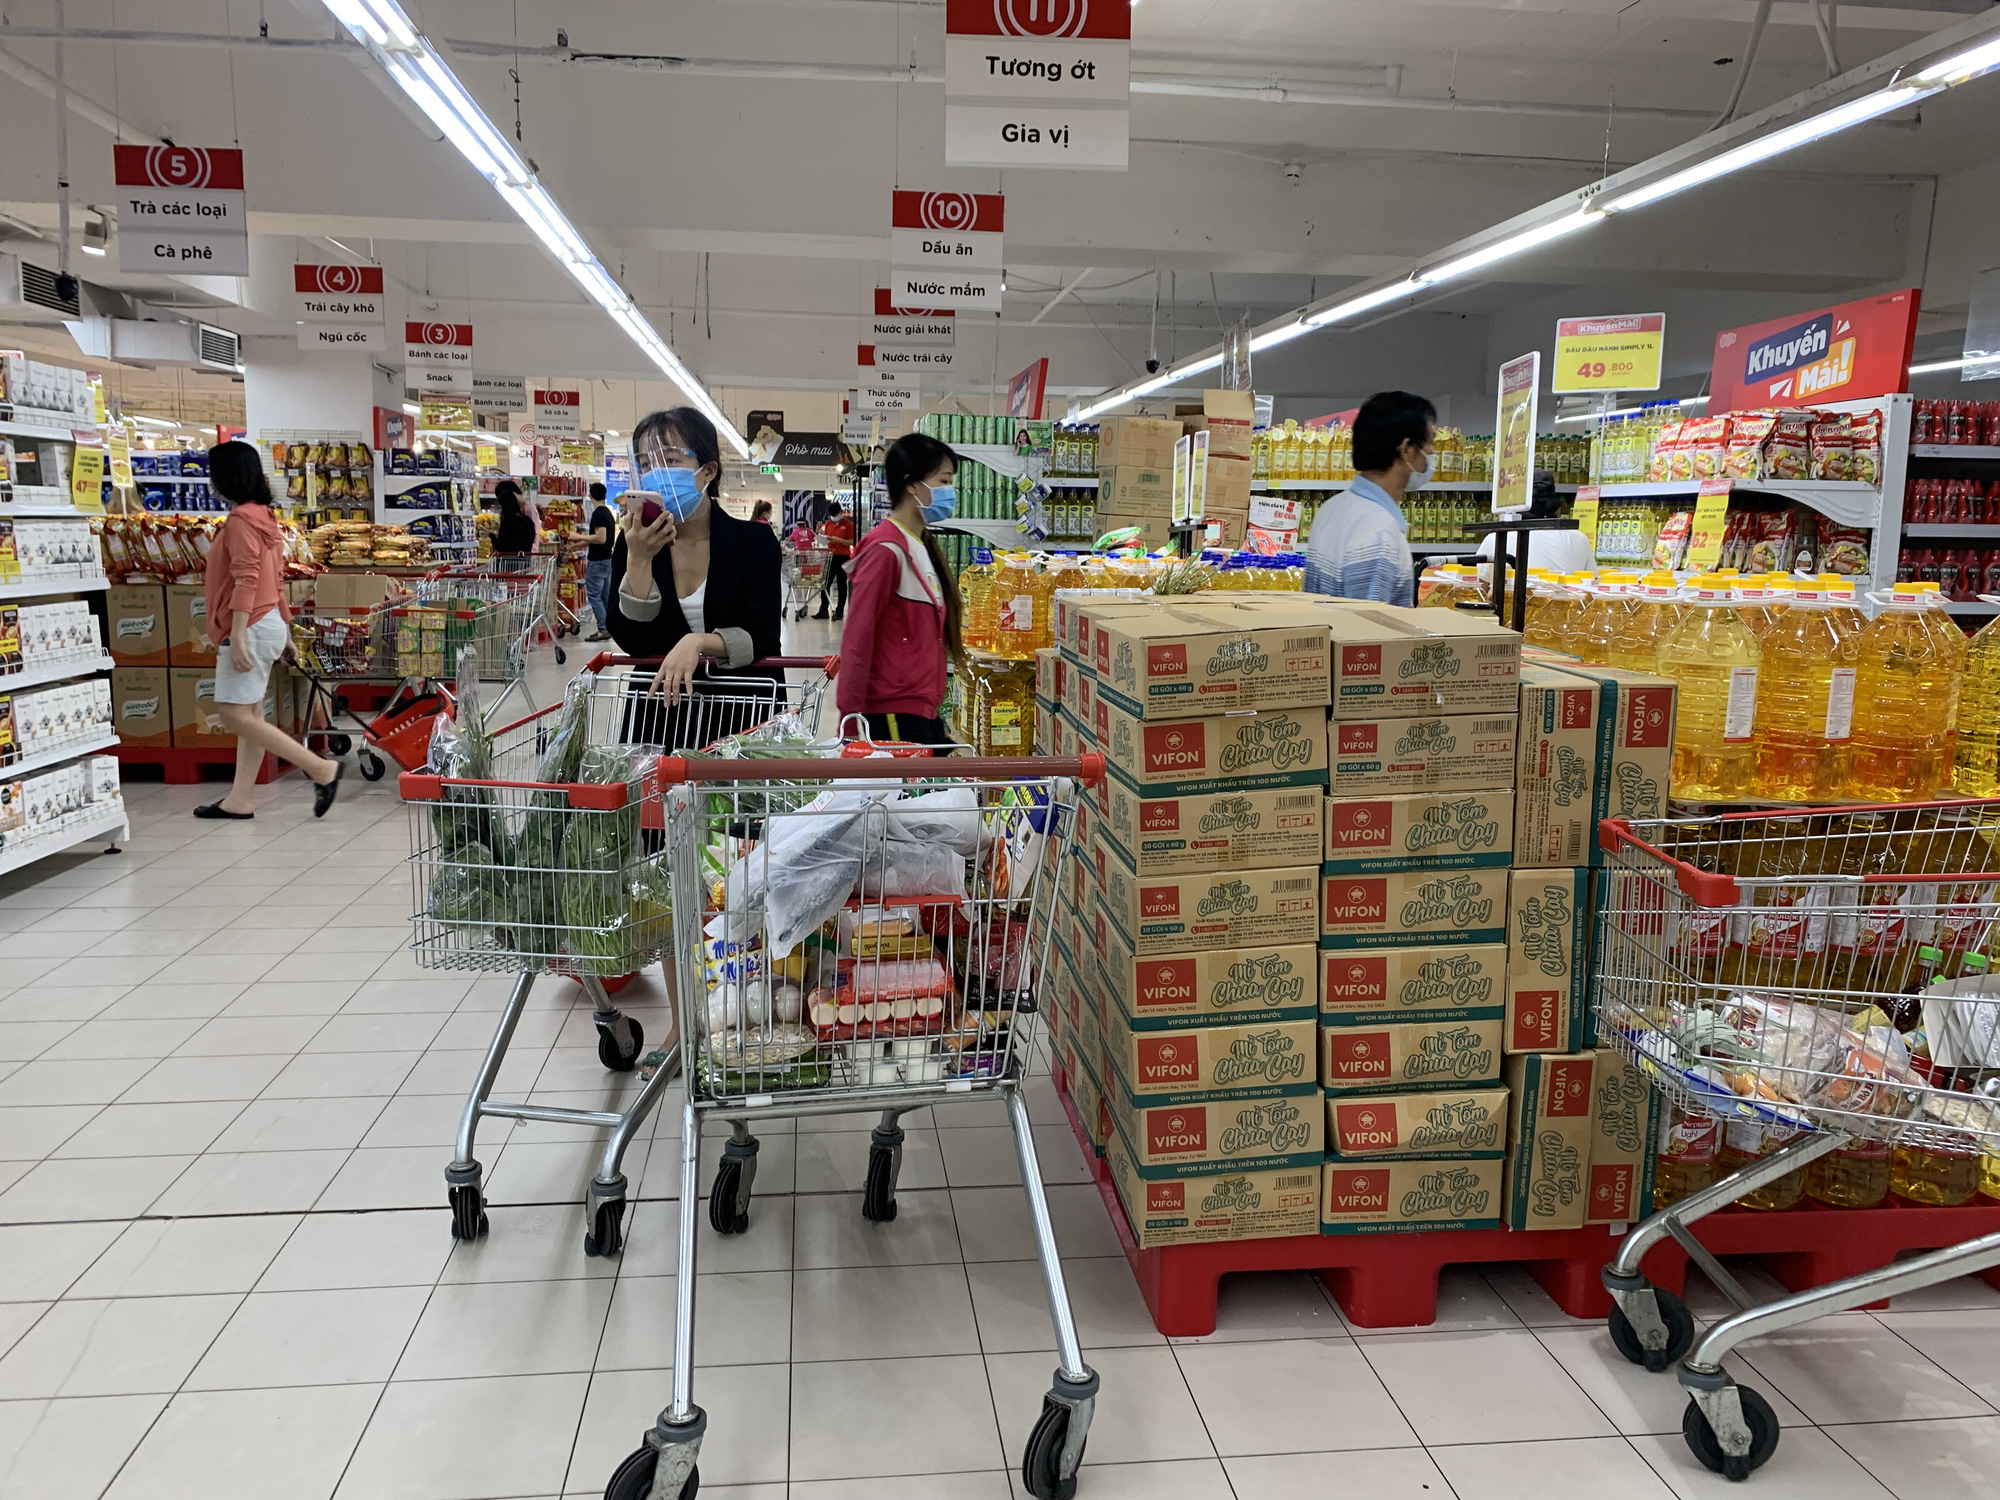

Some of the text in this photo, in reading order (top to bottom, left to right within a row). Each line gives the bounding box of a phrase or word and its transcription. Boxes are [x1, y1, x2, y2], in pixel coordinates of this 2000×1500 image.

[985, 55, 1096, 82] Tương ớt
[1001, 123, 1069, 148] Gia vị
[170, 155, 187, 177] 5
[130, 200, 227, 219] Trà các loại
[936, 200, 963, 221] 10
[154, 244, 212, 261] Cà phê
[955, 243, 973, 256] ăn
[333, 271, 345, 286] 4
[907, 281, 986, 297] Nước mắm
[305, 302, 375, 314] Trái cây khô
[434, 328, 444, 341] 3
[874, 324, 951, 335] Nước giải khát
[319, 331, 367, 343] Ngũ cốc
[409, 350, 468, 361] Bánh các loại
[1747, 323, 1827, 376] Khuyến
[882, 352, 952, 364] Nước trái cây
[1798, 339, 1853, 396] Mãi!
[426, 373, 453, 382] Snack
[473, 379, 522, 389] Bánh các loại
[553, 393, 558, 402] 1
[867, 389, 911, 399] Thức uống
[474, 399, 494, 407] Bánh
[495, 399, 508, 407] các
[509, 399, 523, 408] loại
[785, 443, 833, 457] Phô mai
[1153, 662, 1184, 672] VIFON
[1347, 663, 1377, 672] VIFON
[1566, 694, 1576, 725] VIFON
[1632, 694, 1646, 742] VIFON
[1237, 715, 1299, 746] Mì Tôm
[1343, 741, 1374, 750] VIFON
[1151, 751, 1199, 766] VIFON
[1220, 738, 1312, 773] Chua Cay
[1199, 783, 1216, 791] XUẤT
[1217, 781, 1238, 789] KHẨU
[1270, 775, 1291, 784] NƯỚC
[1424, 797, 1488, 826] Mì Tôm
[1145, 818, 1176, 828] VIFON
[1338, 828, 1385, 842] VIFON
[1405, 820, 1498, 852] Chua Cay
[1383, 859, 1401, 868] XUẤT
[1402, 858, 1421, 867] KHẨU
[1423, 856, 1440, 865] TRÊN
[1454, 856, 1475, 864] NƯỚC
[1146, 904, 1176, 913] VIFON
[1334, 906, 1380, 919] VIFON
[1228, 953, 1293, 985] Mì Tôm
[1143, 985, 1190, 999] VIFON
[1211, 976, 1304, 1008] Chua Cay
[1334, 984, 1380, 996] VIFON
[1540, 996, 1553, 1042] VIFON
[1146, 1064, 1192, 1077] VIFON
[1338, 1060, 1385, 1073] VIFON
[1553, 1067, 1567, 1111] VIFON
[1683, 1120, 1713, 1129] Neptune
[1155, 1134, 1201, 1148] VIFON
[1346, 1131, 1392, 1145] VIFON
[1613, 1170, 1627, 1213] VIFON
[1151, 1200, 1181, 1208] VIFON
[1338, 1195, 1383, 1207] VIFON
